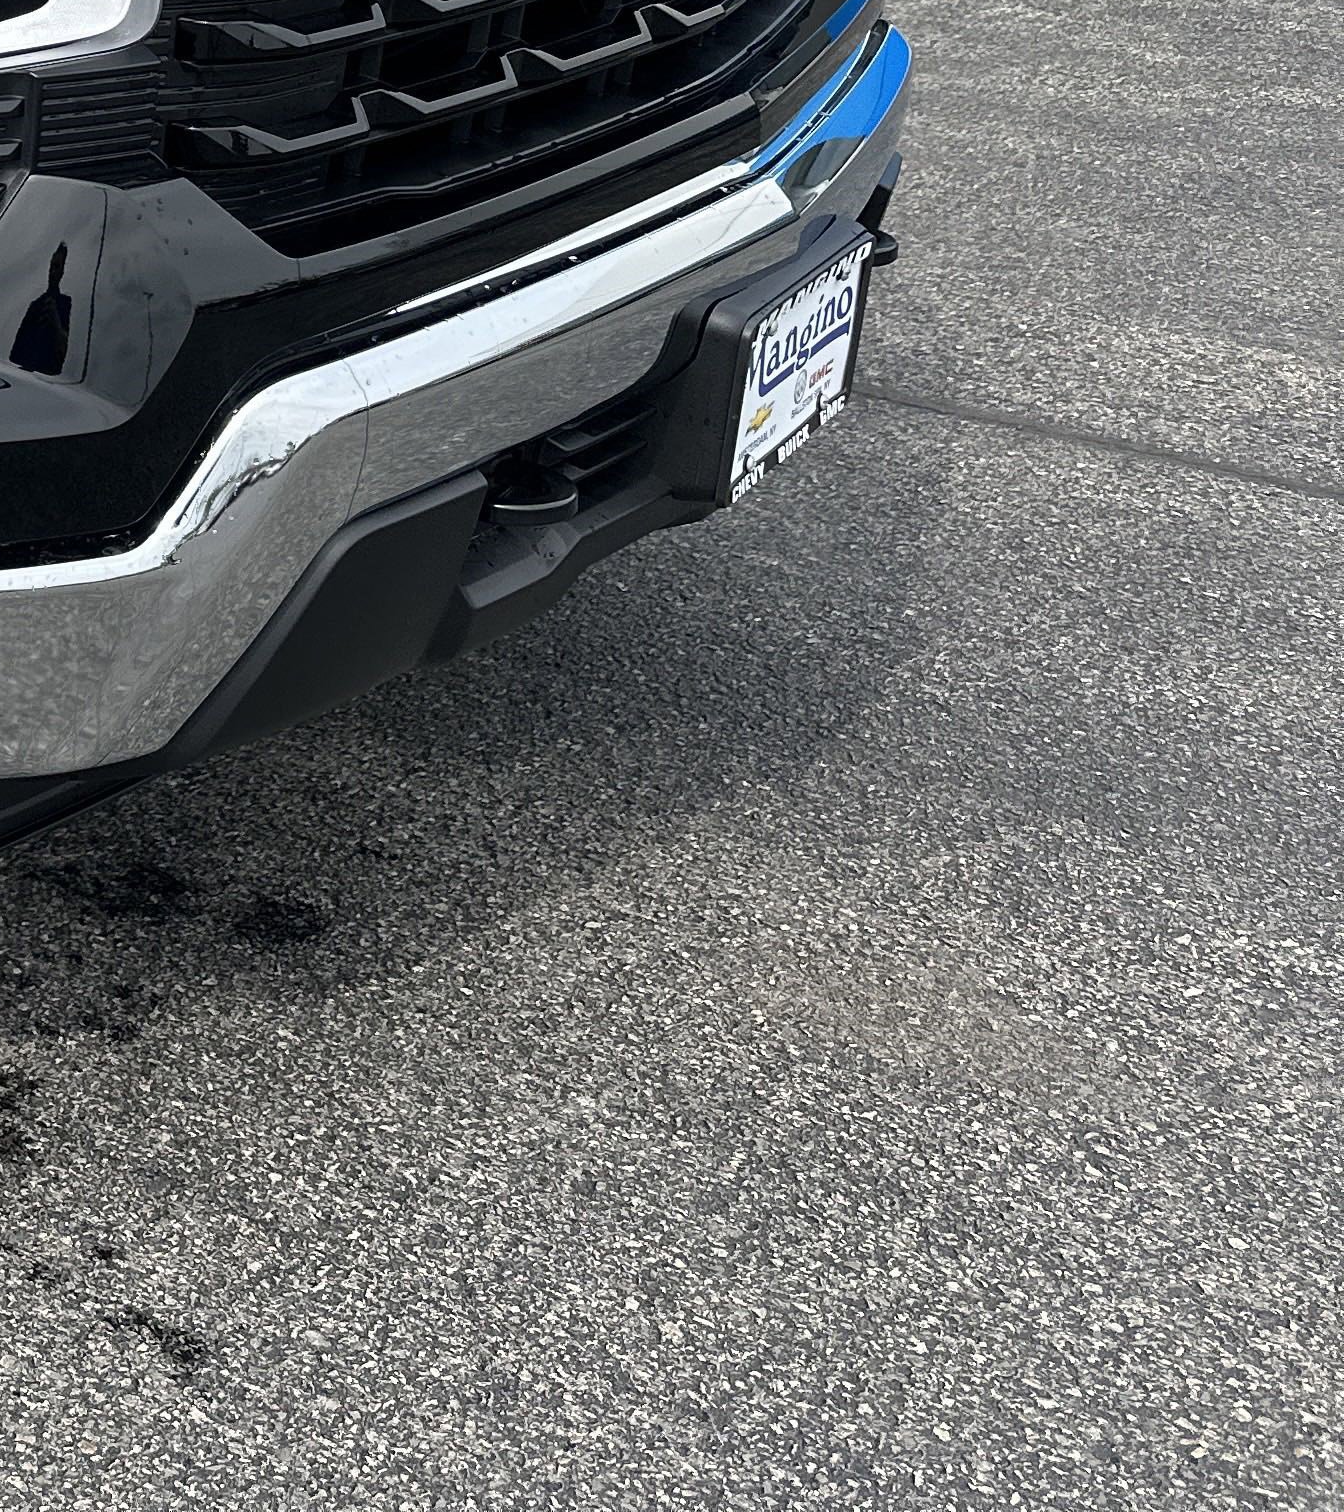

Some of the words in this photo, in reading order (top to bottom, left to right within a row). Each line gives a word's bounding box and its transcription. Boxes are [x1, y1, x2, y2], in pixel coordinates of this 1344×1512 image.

[809, 359, 835, 389] GMC
[732, 462, 765, 504] CHEVY
[777, 424, 810, 464] BUICK
[819, 395, 846, 426] GMC
